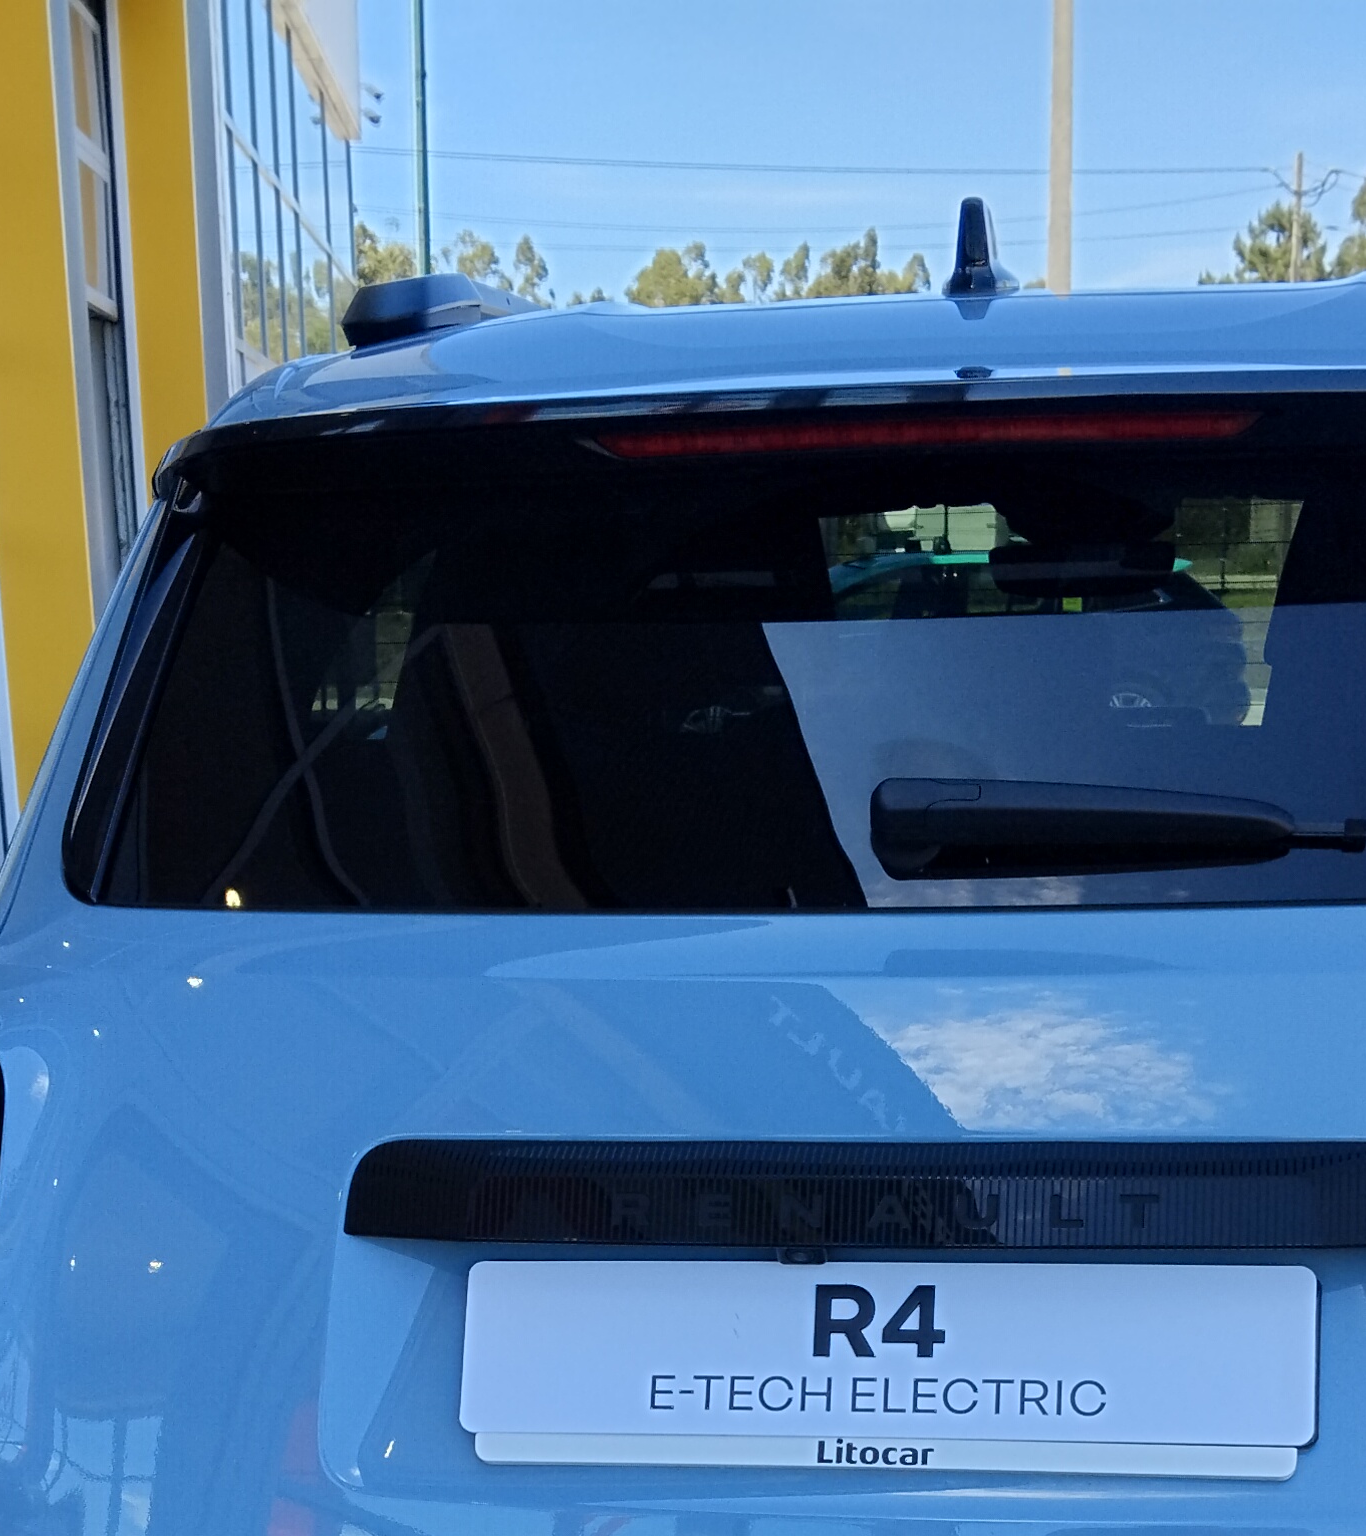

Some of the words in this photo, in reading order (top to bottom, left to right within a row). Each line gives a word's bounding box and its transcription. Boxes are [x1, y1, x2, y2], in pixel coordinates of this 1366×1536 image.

[609, 1192, 1161, 1230] RENAULT
[812, 1283, 946, 1359] R4
[649, 1374, 834, 1413] E-TECH
[850, 1376, 1108, 1418] ELECTRIC
[816, 1438, 935, 1467] Litocar
